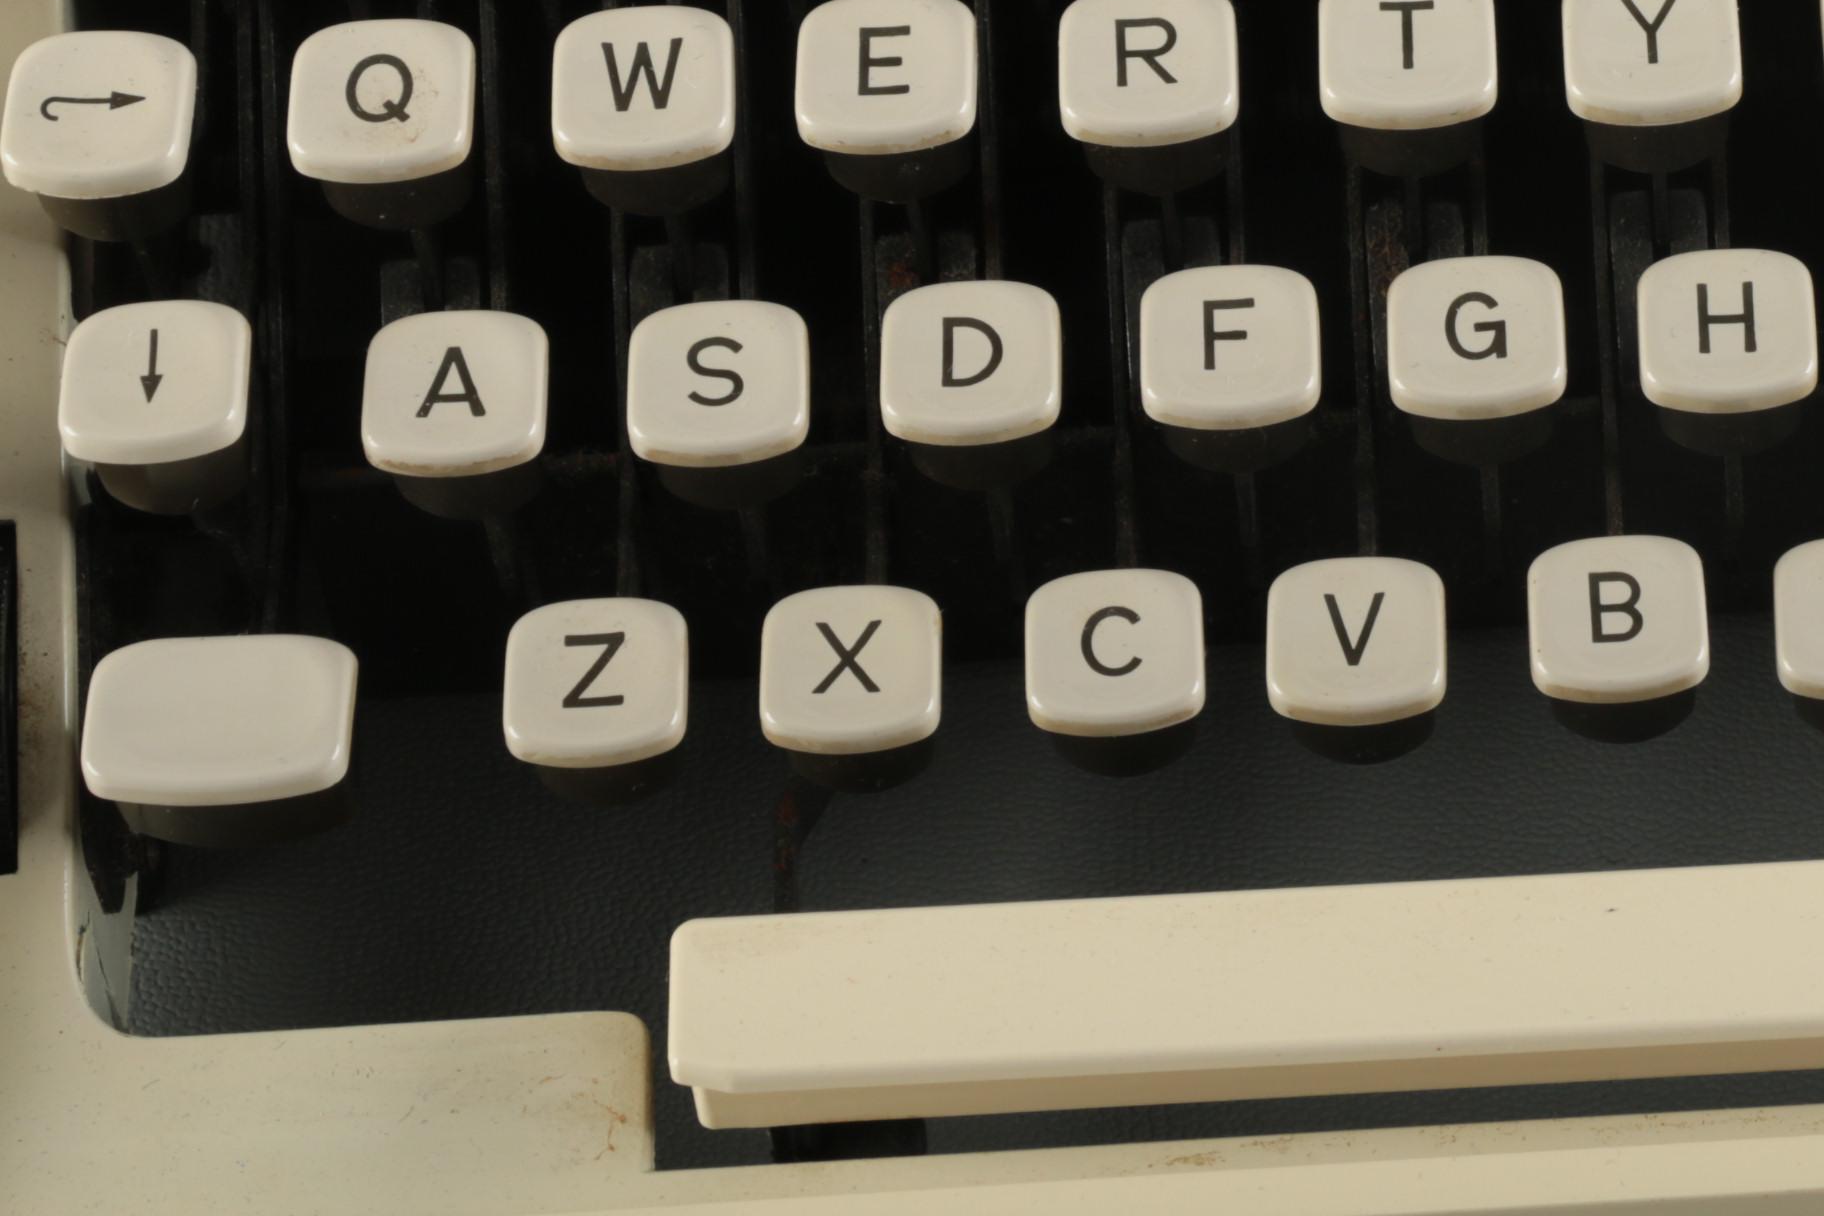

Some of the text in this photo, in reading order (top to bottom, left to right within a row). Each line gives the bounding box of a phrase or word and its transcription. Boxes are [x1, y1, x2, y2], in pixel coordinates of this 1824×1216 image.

[857, 25, 911, 96] E
[1115, 17, 1178, 88] R
[1379, 0, 1435, 70] T
[345, 53, 414, 123] Q
[601, 37, 683, 112] W
[941, 316, 1004, 388] D
[1202, 297, 1255, 371] F
[1444, 291, 1508, 361] G
[1696, 281, 1757, 354] H
[415, 346, 487, 418] A
[686, 336, 744, 407] S
[1080, 605, 1143, 677] C
[1323, 591, 1385, 667] V
[1588, 571, 1644, 644] B
[561, 631, 626, 709] Z
[812, 619, 882, 695] X
